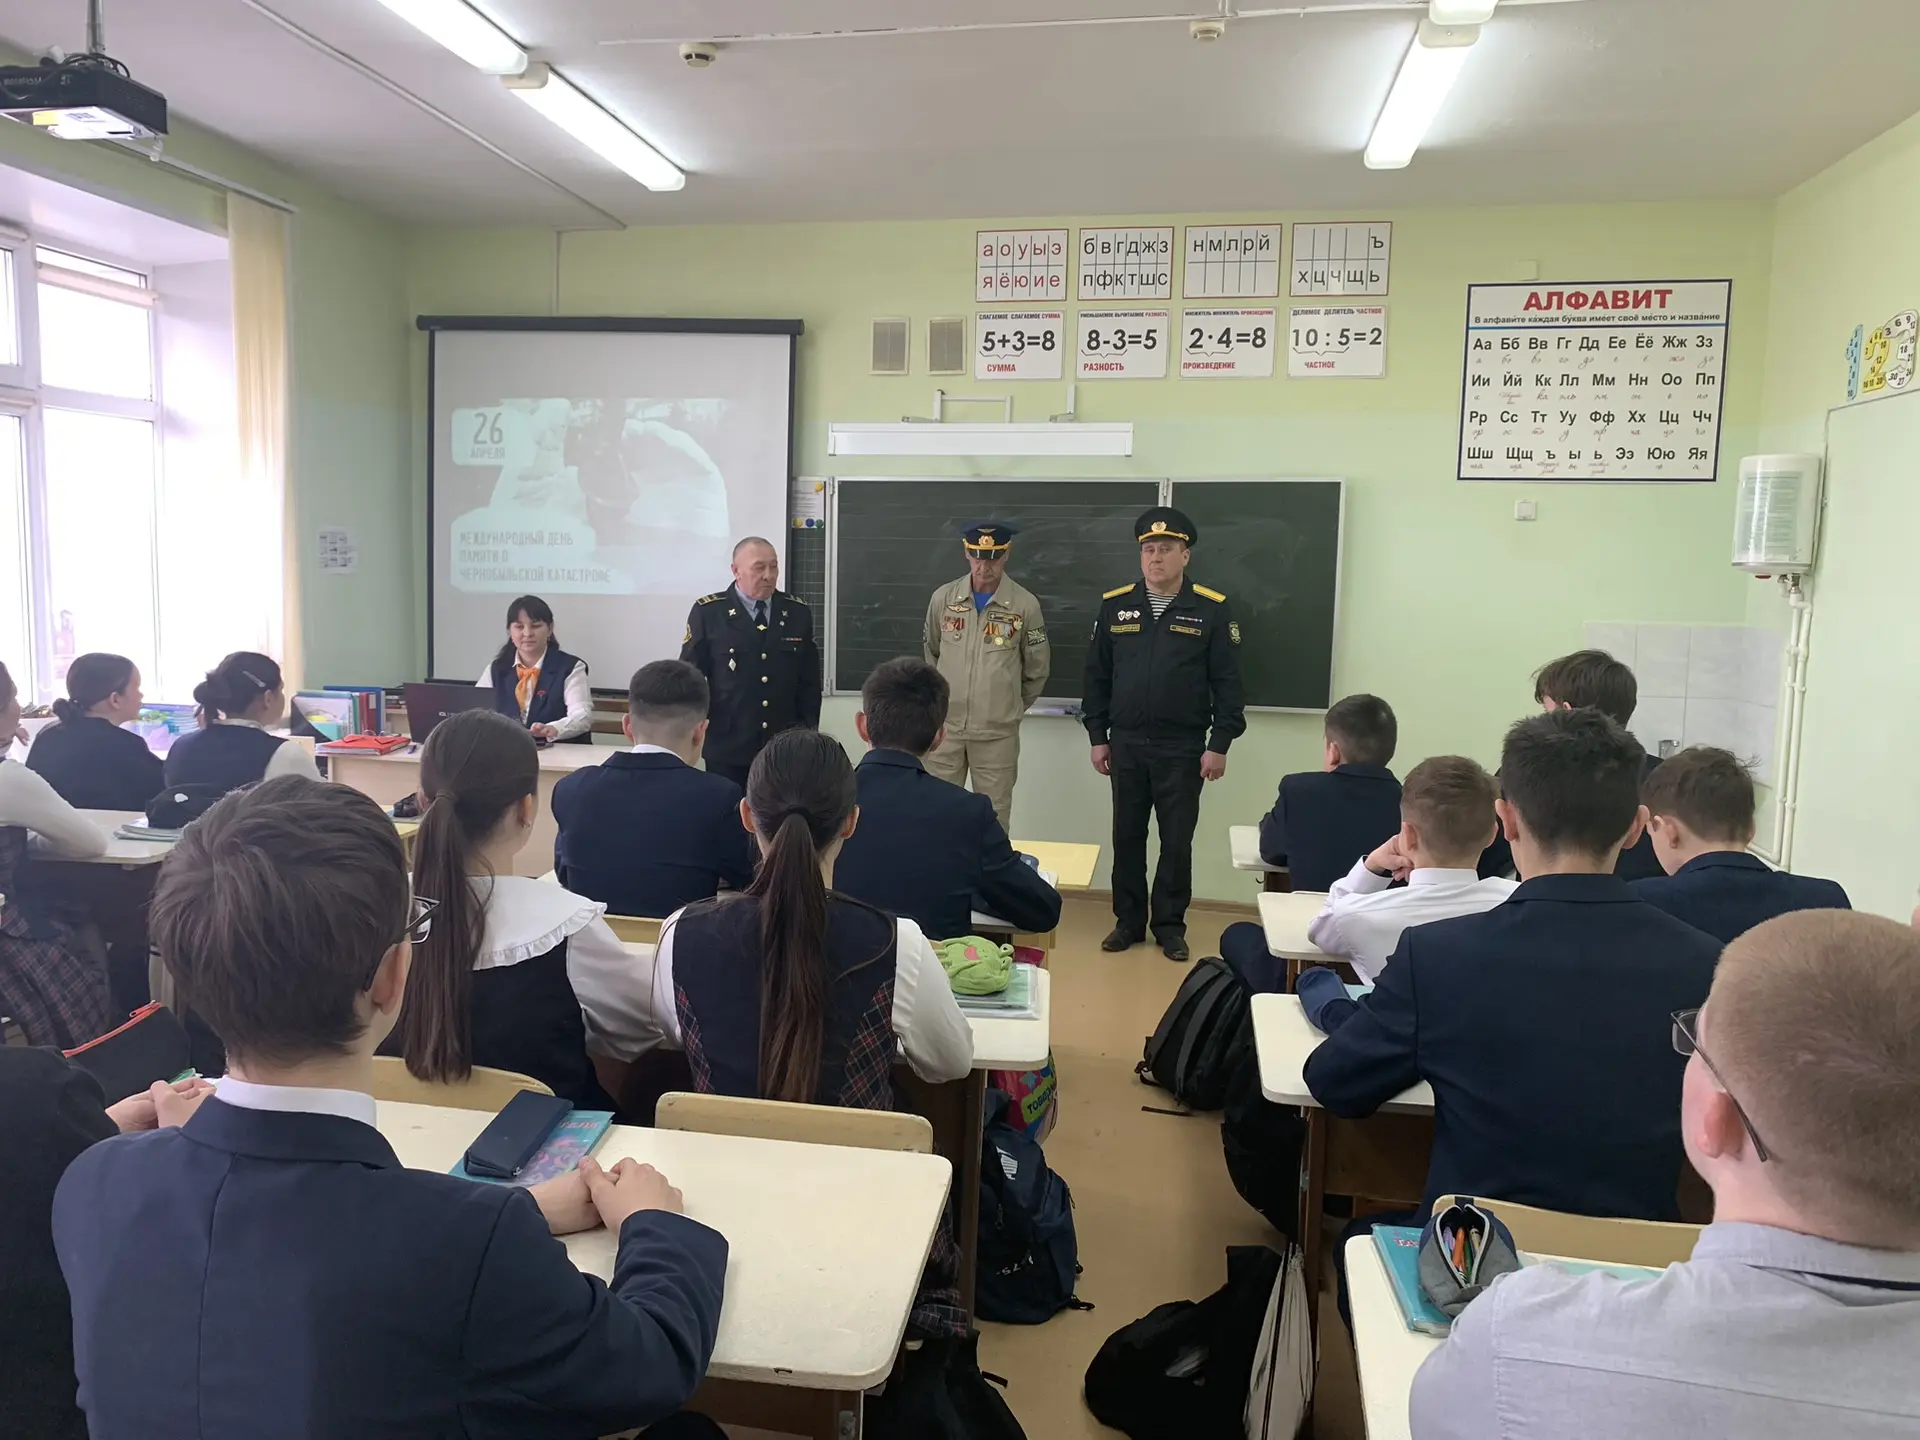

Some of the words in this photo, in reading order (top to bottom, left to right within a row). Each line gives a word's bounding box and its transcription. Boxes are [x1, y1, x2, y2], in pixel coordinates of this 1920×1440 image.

[1523, 289, 1673, 311] АЛФАВИТ
[1474, 316, 1481, 324] В
[1885, 328, 1891, 336] 3
[1895, 319, 1901, 327] 6
[1473, 338, 1492, 350] Аа
[1500, 337, 1519, 349] Бб
[1529, 338, 1547, 349] Вв
[1557, 338, 1571, 349] Гг
[1579, 337, 1599, 351] Дд
[1609, 336, 1626, 348] Ее
[1636, 333, 1653, 348] Ёё
[1662, 336, 1688, 348] Жж
[1696, 335, 1713, 348] Зз
[987, 364, 1016, 372] СУММА
[1084, 363, 1124, 371] РАЗНОСТЬ
[1183, 362, 1235, 370] ПРОИЗВЕДЕНИЕ
[1472, 375, 1490, 387] Ии
[1503, 371, 1522, 386] Йй
[1535, 374, 1551, 386] Кк
[1559, 374, 1579, 387] Лл
[1592, 373, 1615, 386] Мм
[1629, 373, 1648, 385] Нн
[1661, 373, 1682, 385] Оо
[1696, 373, 1715, 385] Пп
[1470, 411, 1487, 425] Рр
[1500, 411, 1518, 423] Сс
[1531, 411, 1547, 423] Тт
[1560, 411, 1576, 426] Уу
[1590, 411, 1615, 425] Фф
[1628, 411, 1646, 422] Хх
[1660, 410, 1679, 424] Цц
[1693, 410, 1711, 422] Чч
[473, 412, 503, 444] 26
[1467, 447, 1493, 459] Шш
[1506, 447, 1533, 461] Щщ
[1546, 450, 1555, 459] ъ
[1569, 451, 1581, 459] ы
[1594, 451, 1602, 459] ь
[1616, 447, 1634, 460] Ээ
[1647, 447, 1675, 460] Юю
[1688, 447, 1707, 459] Яя
[460, 529, 544, 546] МЕЖДУНАРОДНЫЙ
[548, 532, 573, 546] ДЕНЬ
